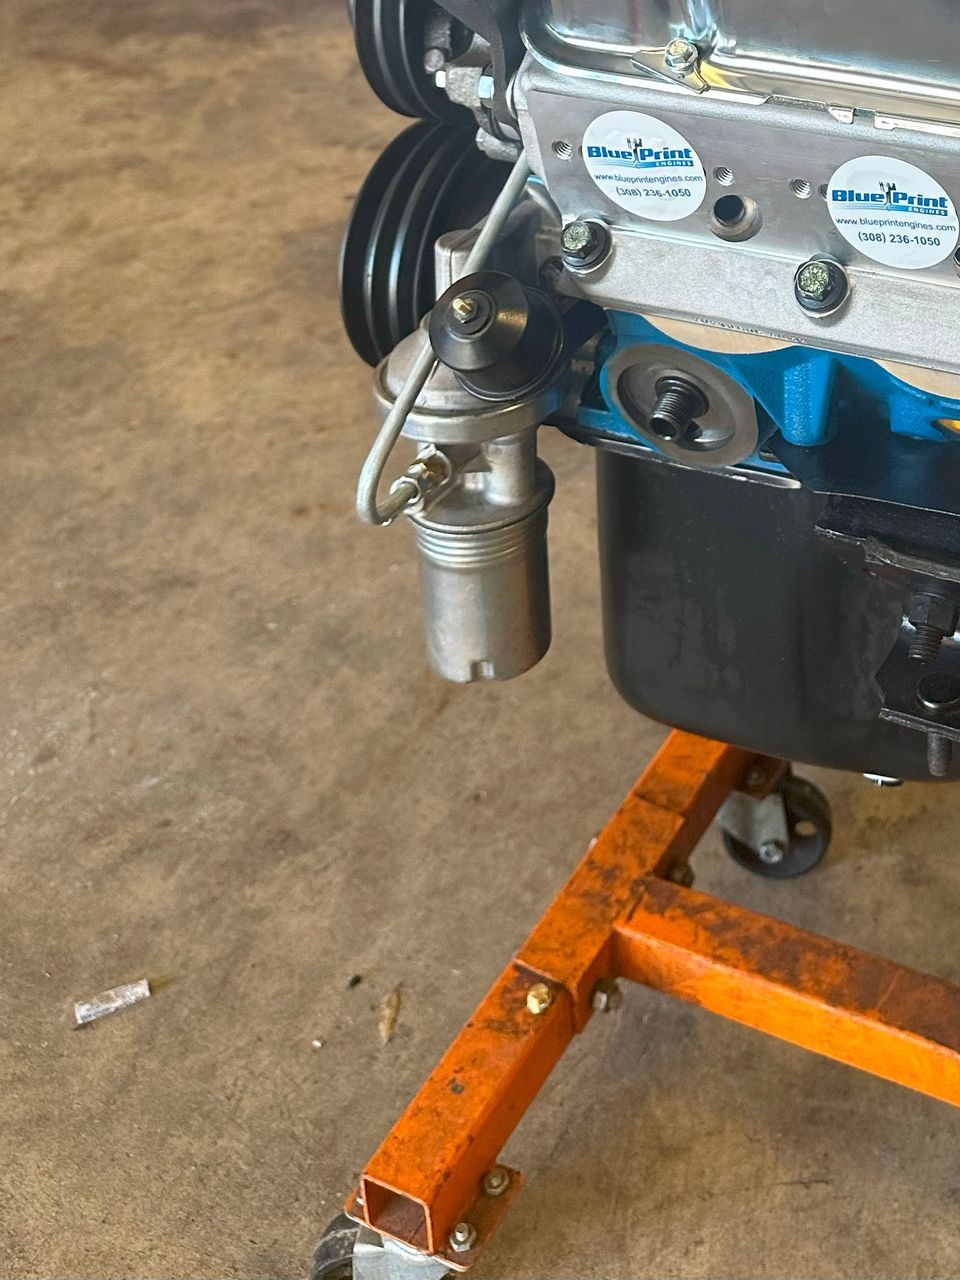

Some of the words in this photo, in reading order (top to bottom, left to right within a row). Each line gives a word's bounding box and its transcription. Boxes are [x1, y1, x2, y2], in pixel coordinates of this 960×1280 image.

[594, 174, 704, 185] www.blueprintengines.com
[616, 186, 642, 197] (308)
[643, 188, 691, 198] 236-1050
[908, 206, 945, 216] ENGINES
[835, 218, 956, 231] www.blueprintengines.com
[858, 231, 886, 244] (308)
[889, 234, 941, 246] 236-1050
